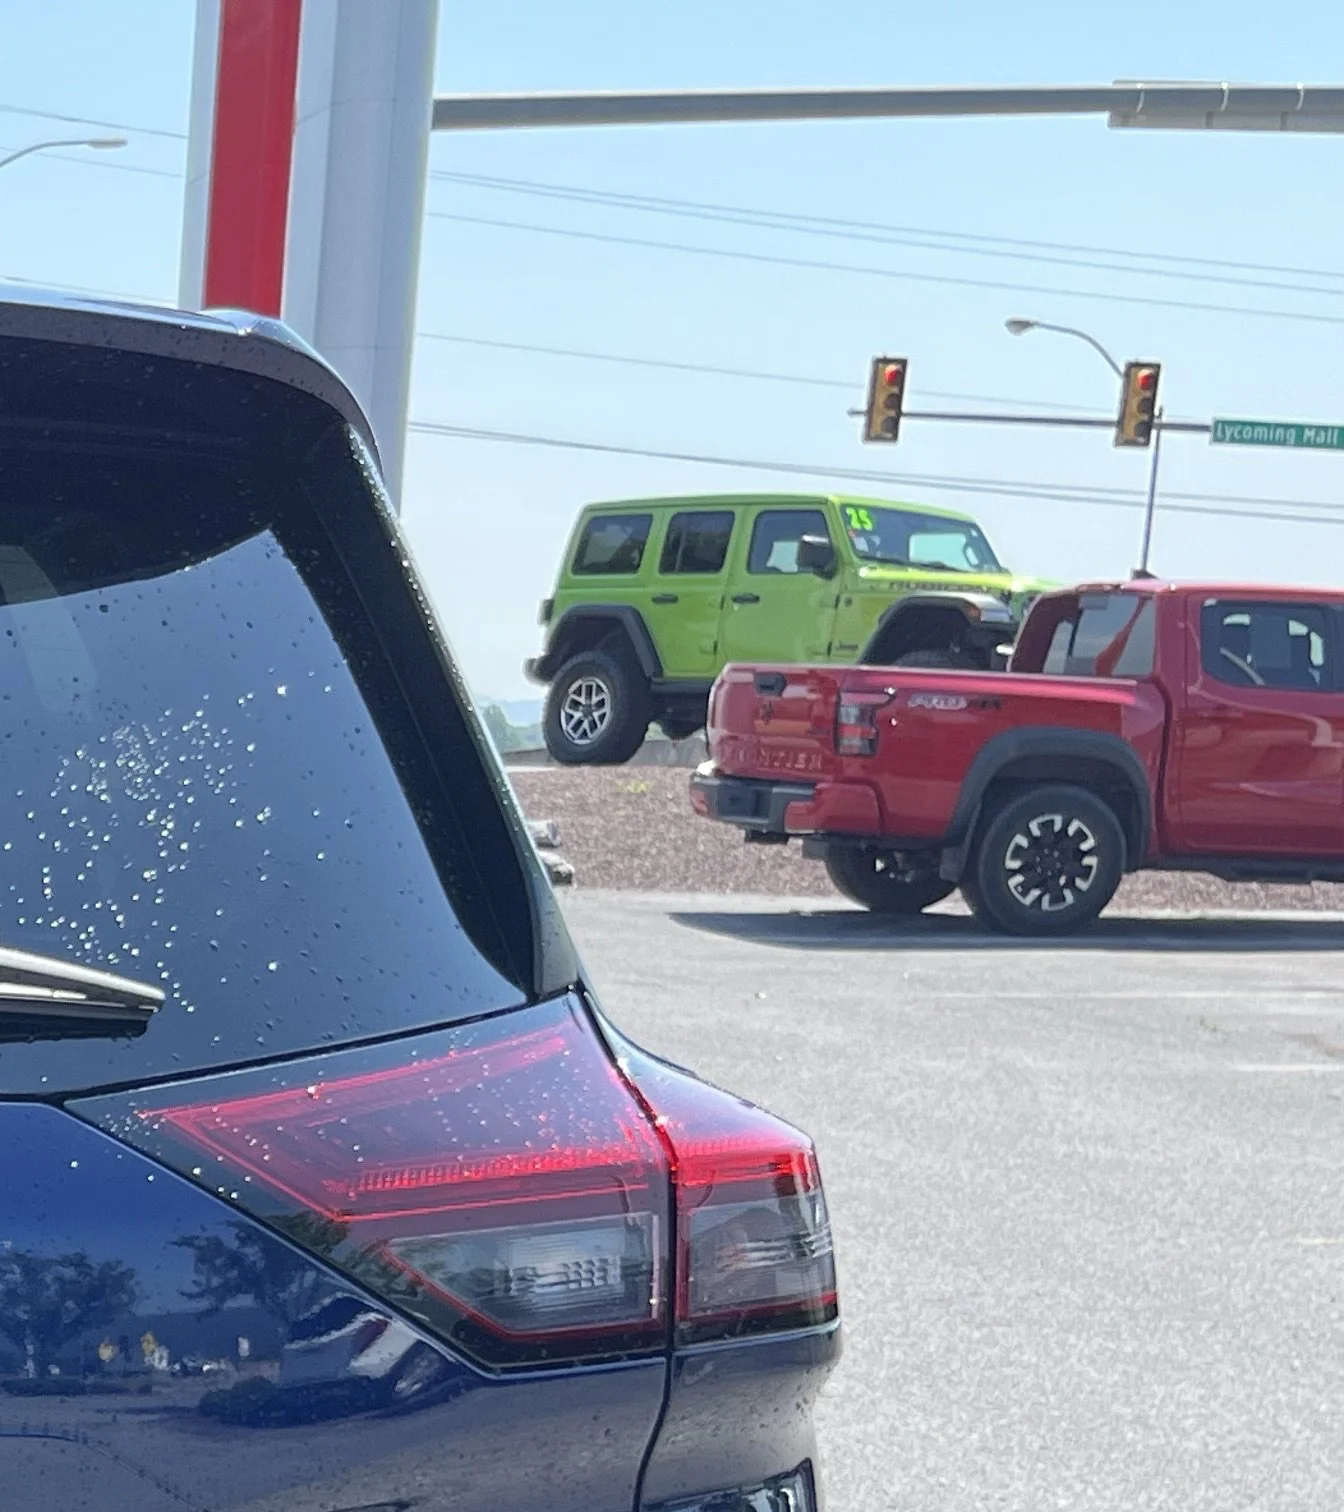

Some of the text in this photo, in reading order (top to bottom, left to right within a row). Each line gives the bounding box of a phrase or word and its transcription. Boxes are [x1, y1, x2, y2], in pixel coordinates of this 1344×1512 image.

[1216, 422, 1339, 446] Lycoming Mall
[846, 507, 873, 531] 25
